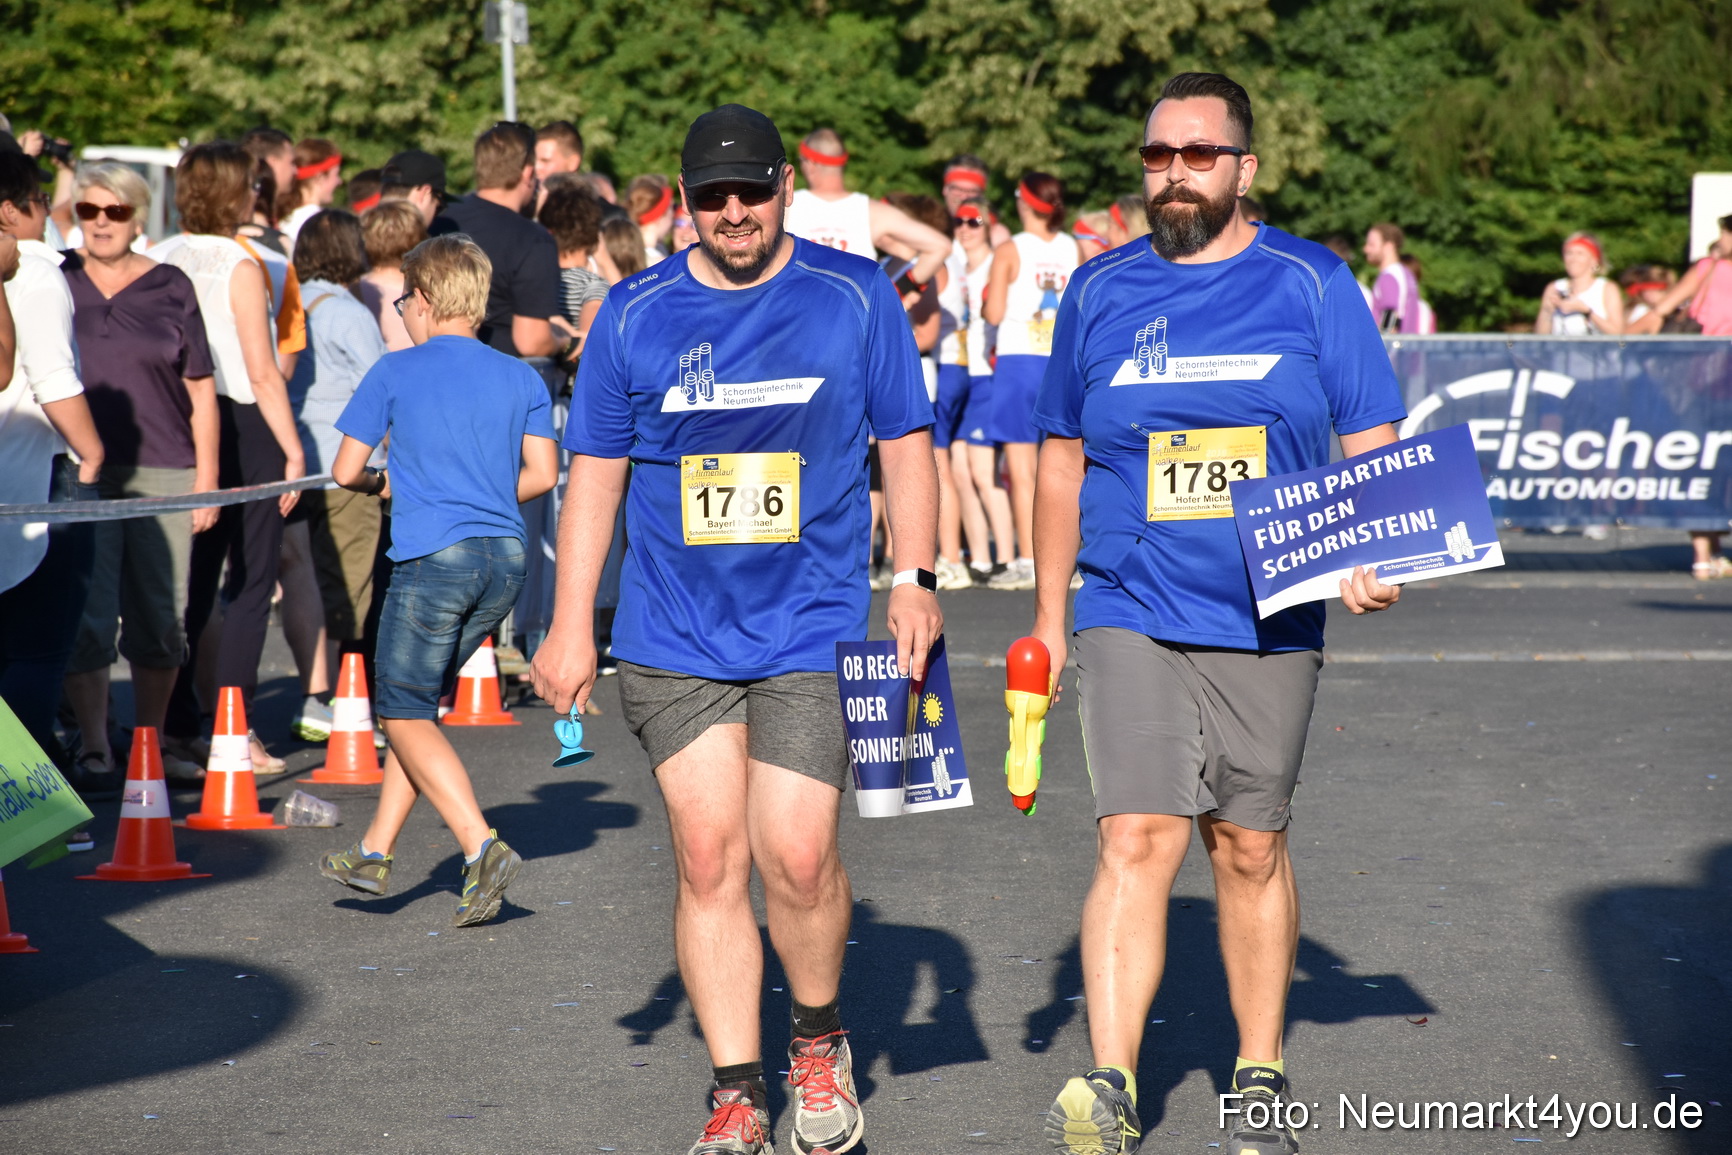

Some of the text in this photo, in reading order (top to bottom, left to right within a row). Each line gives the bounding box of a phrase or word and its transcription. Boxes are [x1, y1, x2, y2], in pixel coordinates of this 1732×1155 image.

[1100, 252, 1121, 263] JAKO
[638, 273, 659, 285] JAKO
[1175, 359, 1259, 370] Schornsteintechnik
[1175, 369, 1218, 379] Neumarkt
[722, 382, 804, 397] Schornsteintechnik
[723, 395, 766, 406] Neumarkt
[1163, 459, 1250, 494] 1783
[1274, 481, 1321, 511] IHR
[1324, 443, 1436, 495] PARTNER
[1486, 476, 1711, 501] AUTOMOBILE
[696, 485, 784, 518] 1786
[1175, 494, 1231, 504] Hofer Micha
[1153, 504, 1211, 512] Schornsteintechnik
[707, 519, 773, 529] Bayerl Mchael
[1254, 497, 1356, 550] FÜR DEN
[1261, 508, 1438, 580] SCHORNSTEIN!
[1383, 556, 1444, 571] Schornsteintechnik
[1413, 561, 1445, 571] Neumarkt
[843, 654, 913, 681] OB REG
[846, 696, 888, 723] ODER
